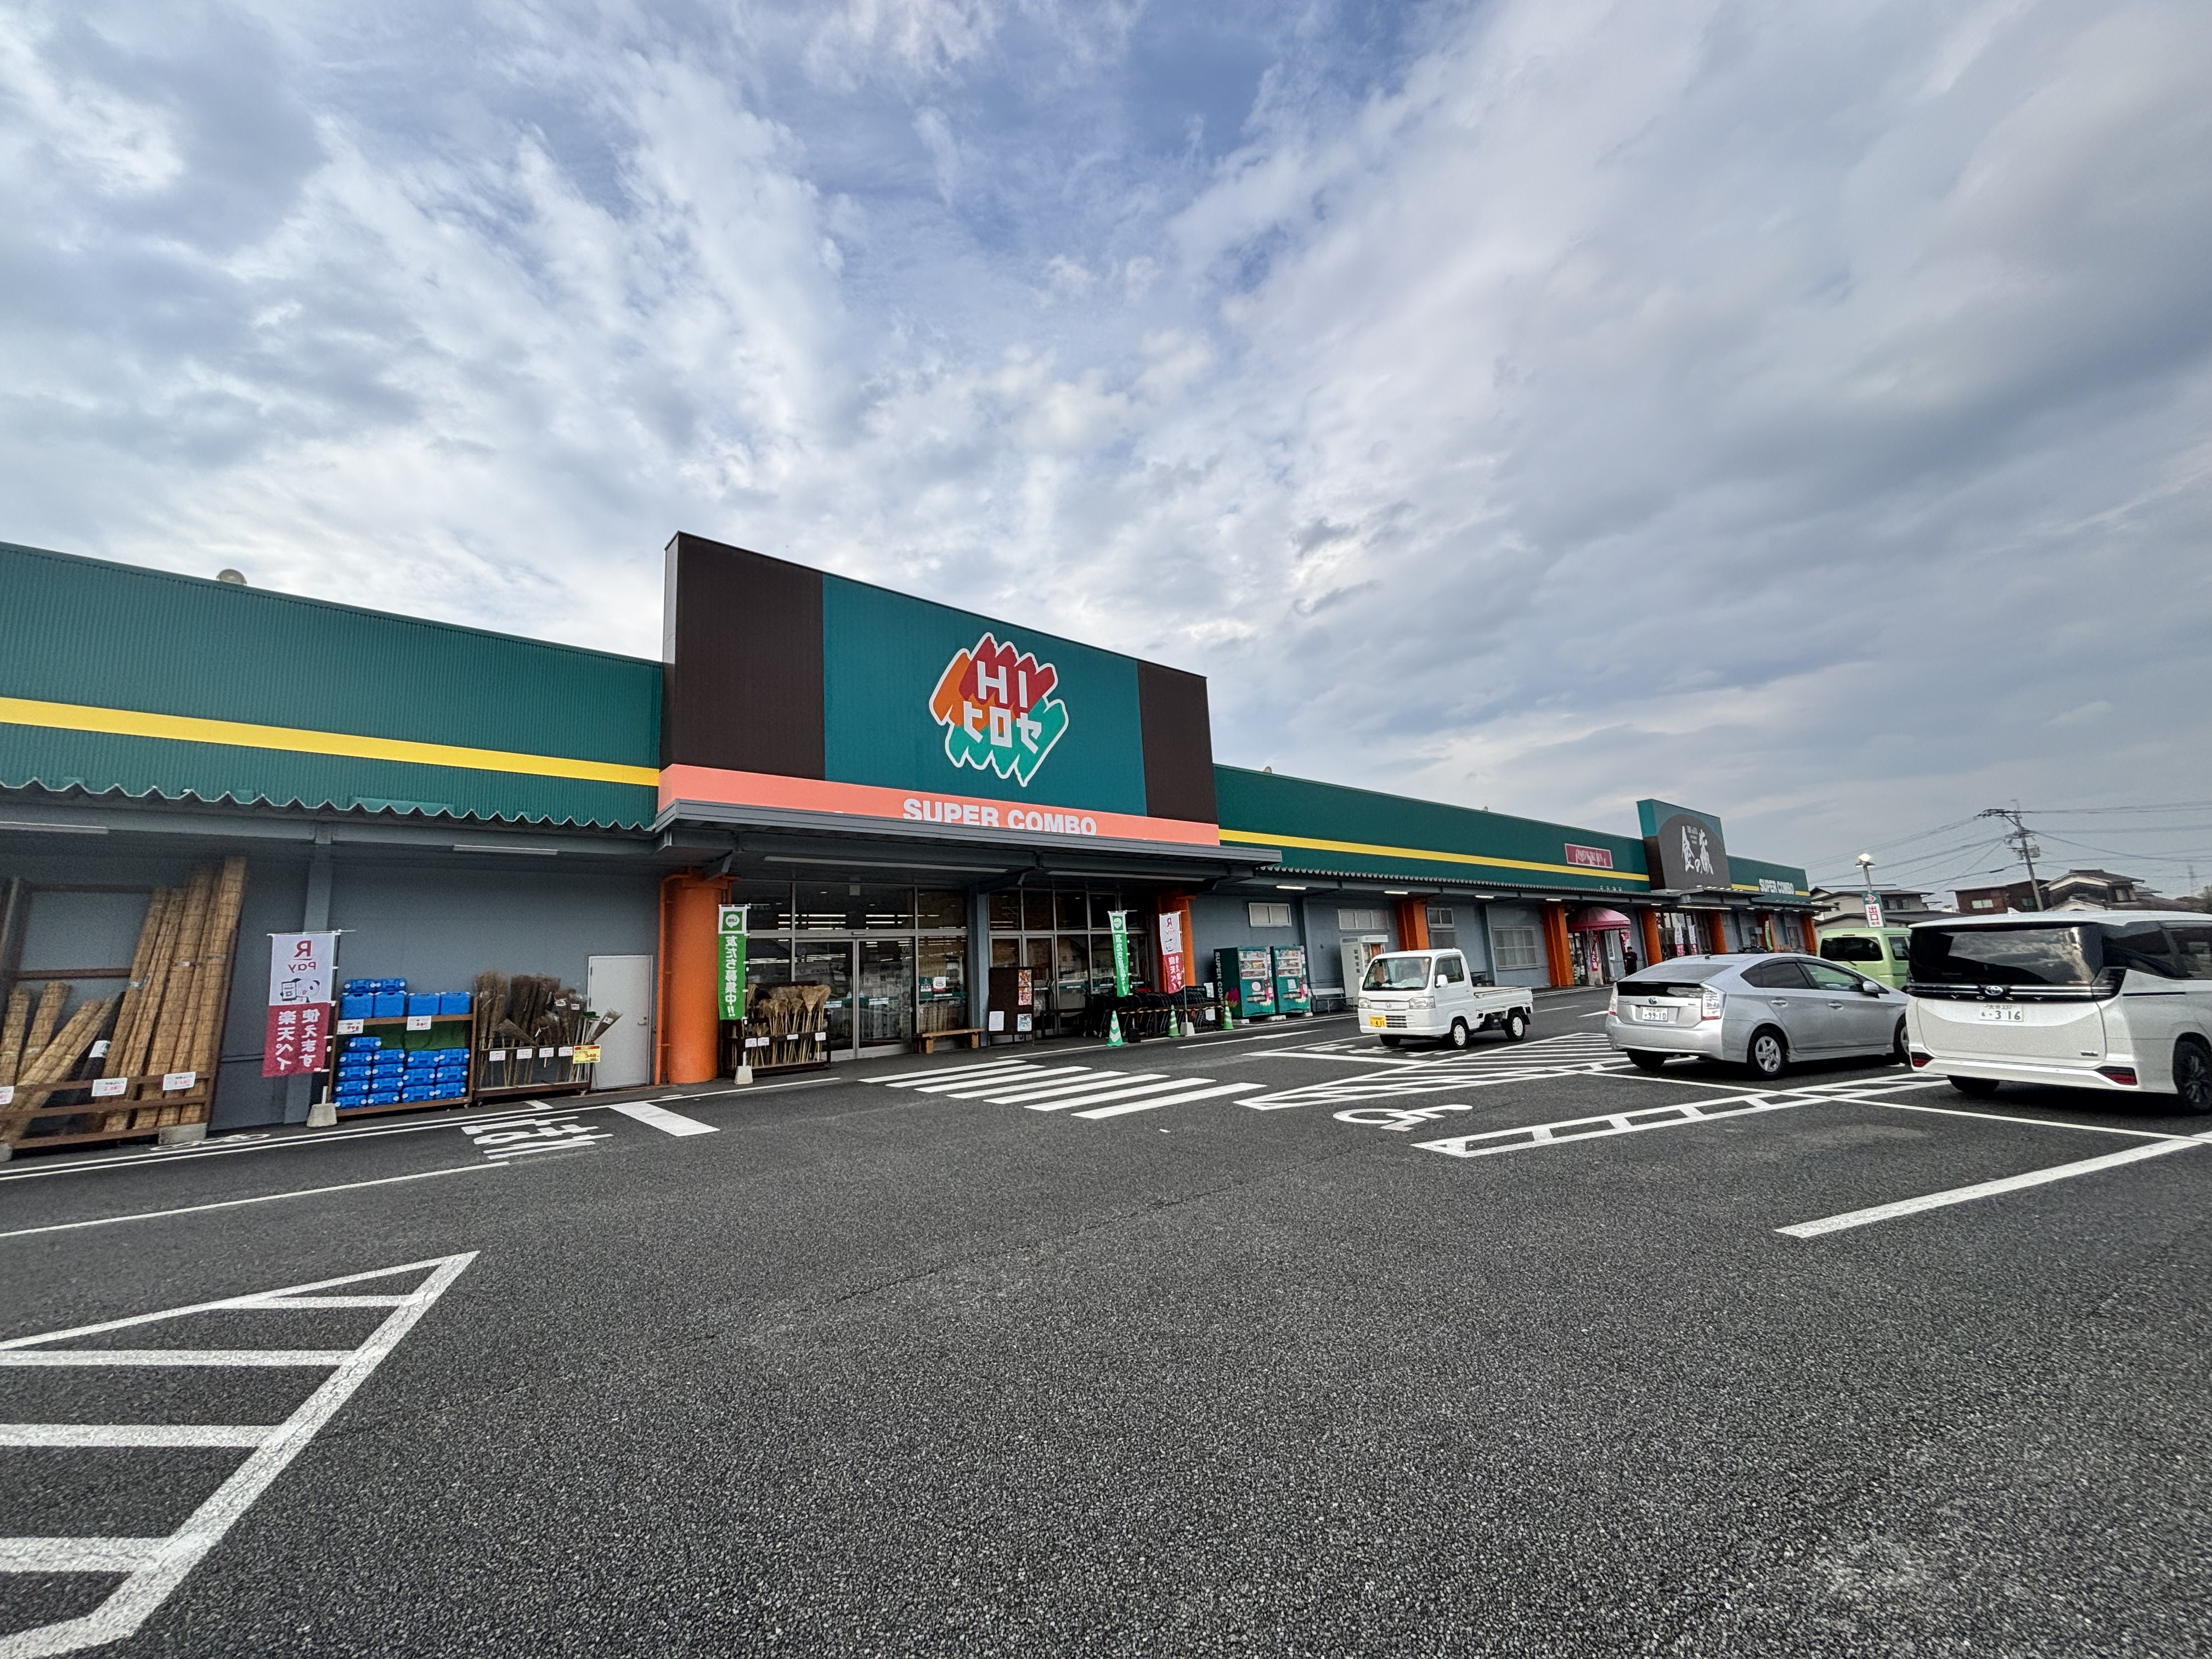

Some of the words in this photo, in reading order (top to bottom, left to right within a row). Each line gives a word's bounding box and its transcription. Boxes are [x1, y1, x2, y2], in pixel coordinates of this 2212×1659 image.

[977, 660, 1028, 708] HI
[963, 701, 1042, 754] ヒロセ
[902, 798, 1000, 827] SUPER
[1007, 809, 1097, 836] COMBO
[1759, 878, 1778, 894] SUPER
[1777, 881, 1795, 895] COMBO
[1868, 906, 1879, 921] 出口
